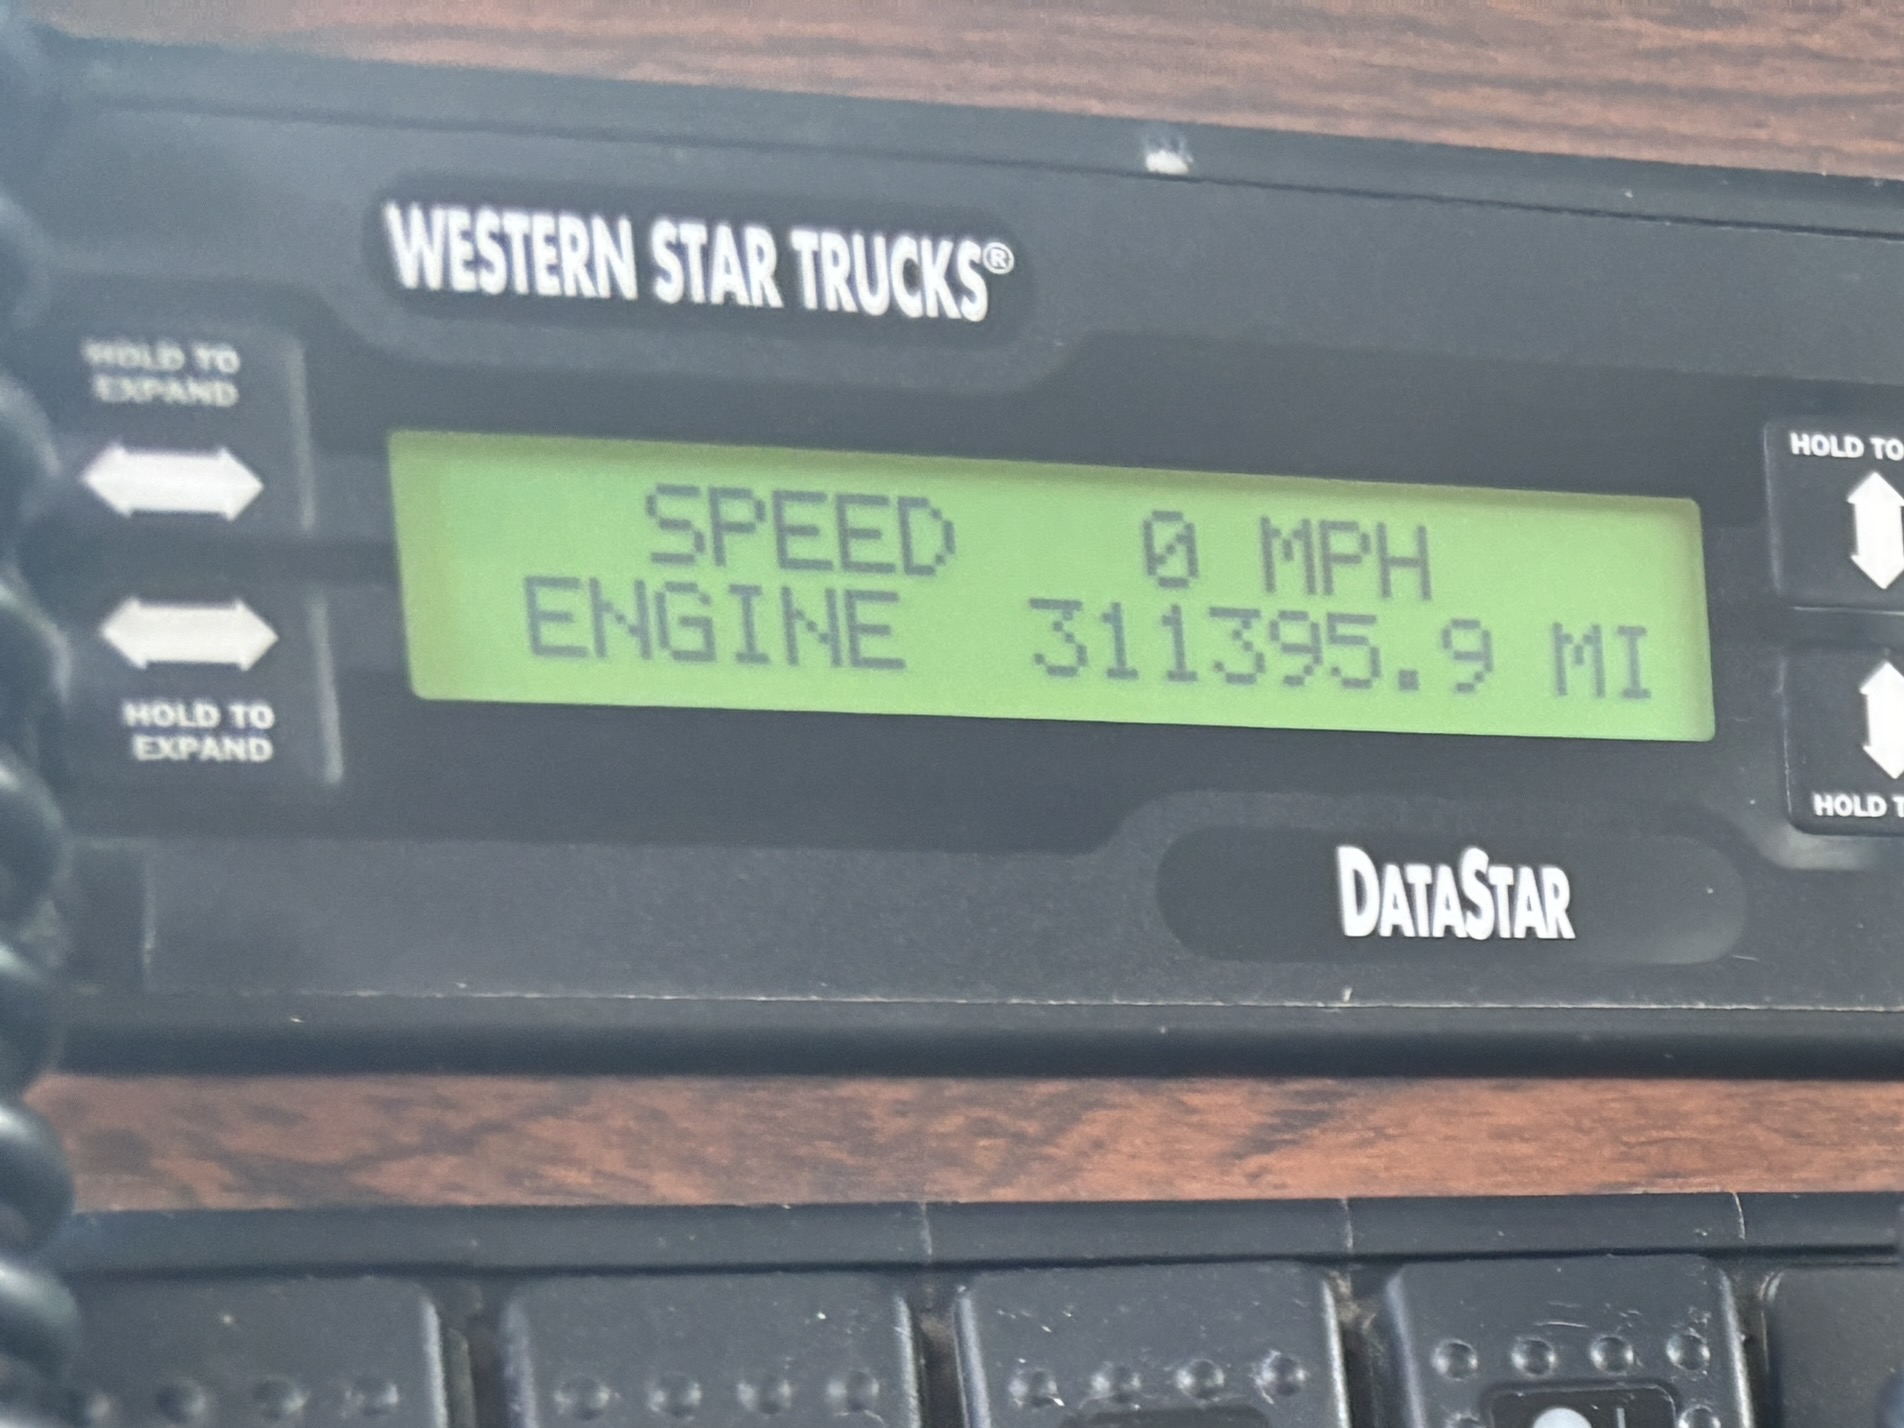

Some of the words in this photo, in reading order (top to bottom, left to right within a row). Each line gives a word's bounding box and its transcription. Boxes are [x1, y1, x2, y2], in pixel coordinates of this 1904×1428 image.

[385, 201, 638, 302] WESTERN
[653, 218, 782, 311] STAR
[193, 342, 240, 374] TO
[1790, 432, 1867, 461] HOLD
[646, 482, 956, 577] SPEED
[1143, 510, 1197, 589] 0
[1259, 516, 1432, 602] MPH
[524, 575, 907, 674] ENGINE
[1028, 594, 1495, 697] 311395.9
[1553, 621, 1650, 702] MI
[125, 701, 221, 728] HOLD
[229, 704, 275, 729] TO
[133, 733, 274, 762] EXPAND
[1813, 793, 1889, 818] HOLD
